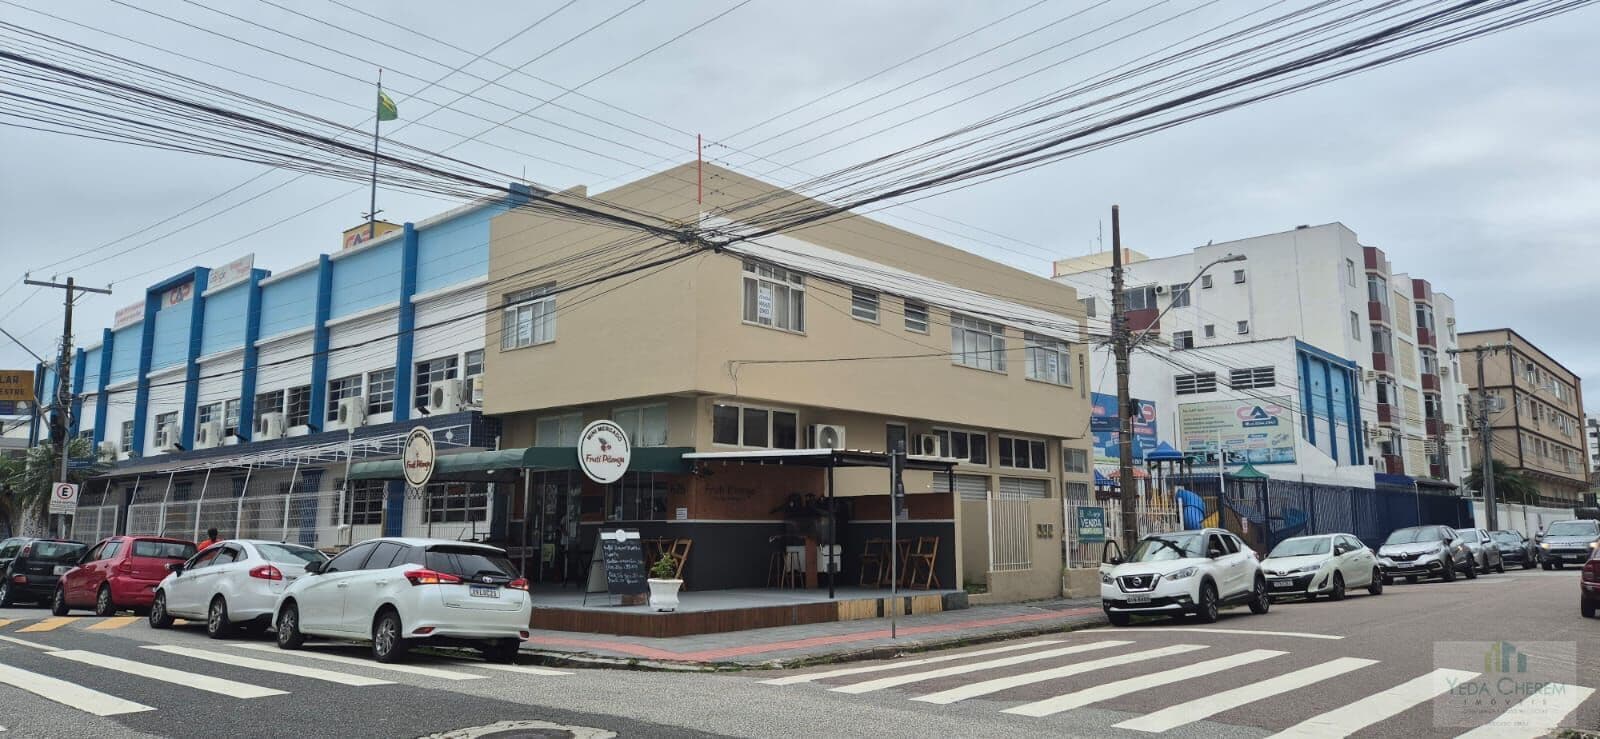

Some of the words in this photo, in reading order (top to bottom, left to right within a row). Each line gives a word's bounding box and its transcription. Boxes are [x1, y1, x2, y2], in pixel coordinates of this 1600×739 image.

[598, 426, 623, 441] MERCADO
[586, 454, 602, 463] Fruti
[61, 487, 69, 496] E
[1080, 518, 1102, 528] VENDA
